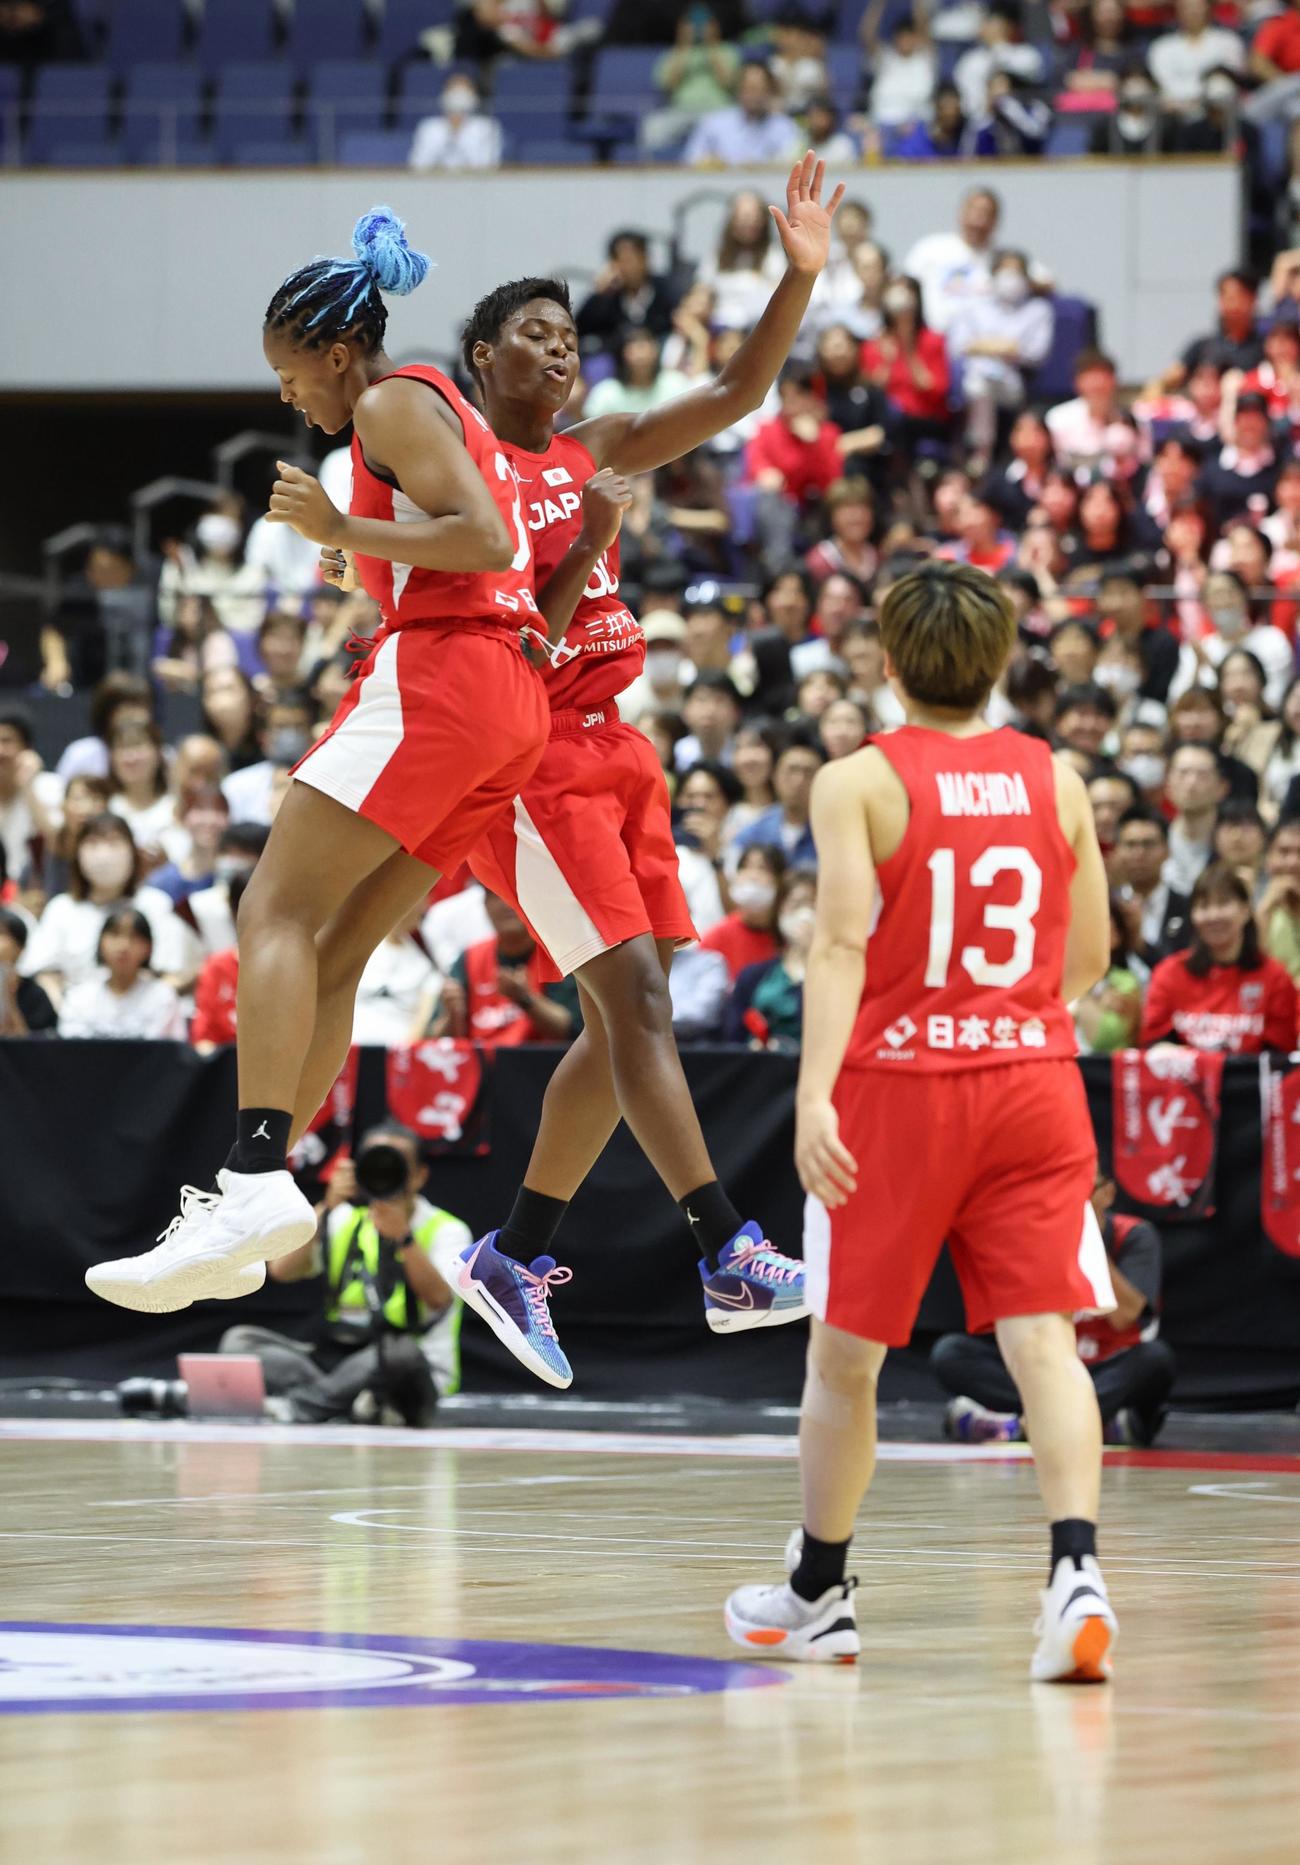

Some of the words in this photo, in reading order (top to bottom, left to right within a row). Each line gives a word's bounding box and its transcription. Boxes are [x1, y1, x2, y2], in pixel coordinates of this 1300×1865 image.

[527, 490, 583, 531] JAP
[583, 638, 627, 653] MITSUI
[582, 711, 605, 728] JPN
[935, 771, 1032, 817] MACHIDA
[923, 846, 1043, 989] 13
